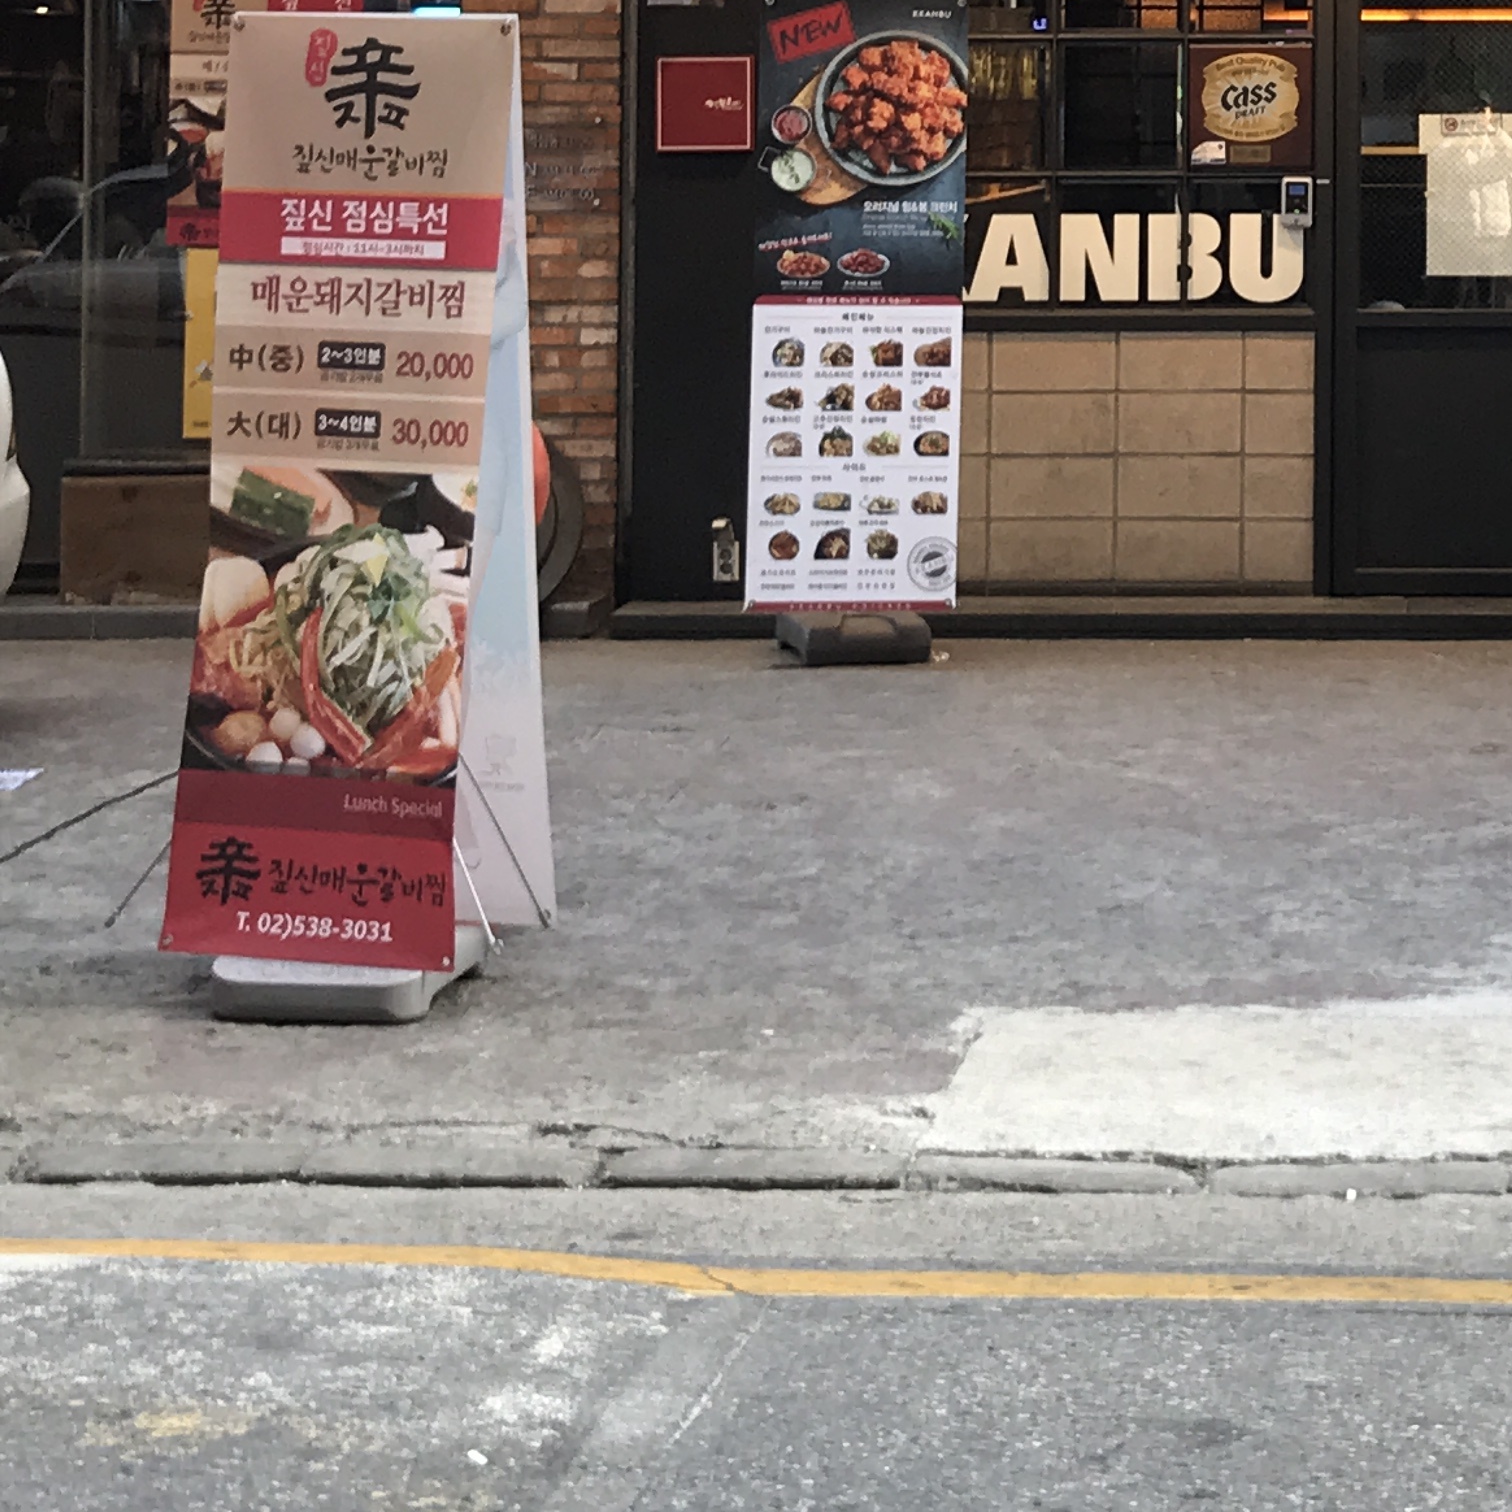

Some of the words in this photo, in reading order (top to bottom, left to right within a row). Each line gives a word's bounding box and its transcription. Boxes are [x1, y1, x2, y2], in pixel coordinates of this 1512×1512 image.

[779, 16, 843, 54] NEW
[1221, 82, 1277, 111] Cass
[281, 199, 333, 232] 짚신
[341, 201, 448, 235] 점심특선
[962, 214, 1304, 303] ANBU
[251, 275, 466, 320] 매운돼지갈비찜
[395, 351, 474, 382] 20,000
[392, 418, 469, 452] 30,000
[343, 794, 388, 813] Lunch
[391, 799, 443, 819] Special
[258, 914, 393, 943] 02)538-3031
